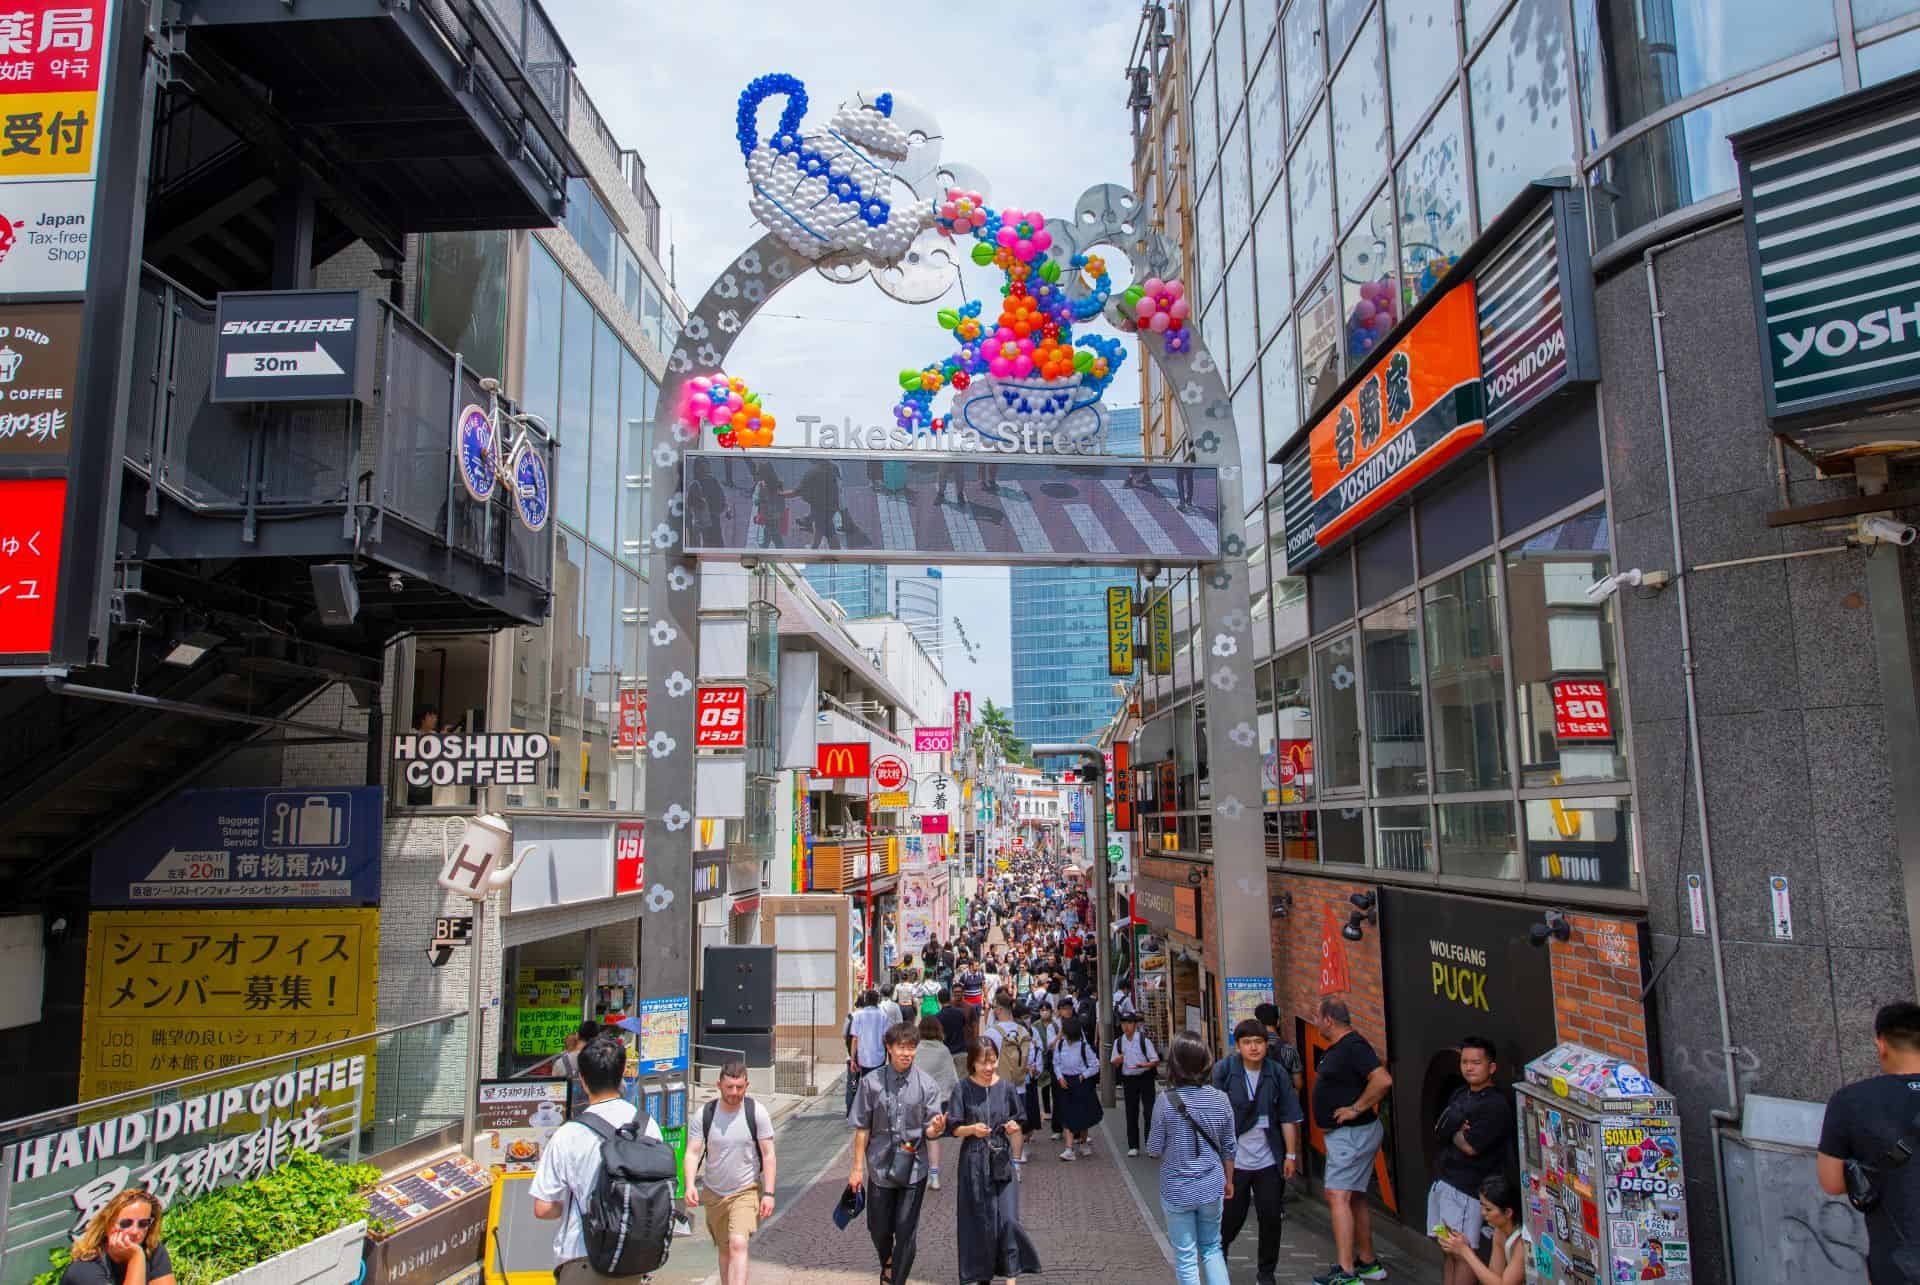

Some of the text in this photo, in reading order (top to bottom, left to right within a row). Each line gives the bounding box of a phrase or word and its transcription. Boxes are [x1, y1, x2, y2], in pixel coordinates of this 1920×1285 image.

[50, 58, 90, 79] 약국
[2, 111, 90, 156] 受付
[36, 212, 86, 228] Japan
[27, 230, 88, 245] Tax-free
[47, 247, 87, 263] Shop
[15, 326, 50, 345] DRIP
[221, 318, 354, 335] SKECHERS
[254, 356, 298, 372] 30m
[1486, 327, 1565, 404] YOSHINOYA
[9, 388, 63, 400] COFFEE
[796, 415, 981, 450] Takeshita
[1338, 428, 1417, 510] YOSHINOYA
[1112, 588, 1130, 664] コインロッカー
[702, 692, 739, 704] クスリ
[700, 708, 741, 727] OS
[700, 731, 741, 741] ドラッグ
[394, 734, 549, 760] HOSHINO
[407, 760, 535, 785] COFFEE
[218, 816, 260, 827] Baggage
[222, 827, 260, 838] Storage
[223, 838, 258, 848] Service
[190, 863, 225, 879] 20m
[236, 852, 348, 878] 荷物預かり
[448, 844, 494, 889] H
[114, 933, 349, 965] シェアオフィス
[1430, 939, 1487, 968] WOLFGANG
[109, 975, 336, 1010] メンバー募集！
[1431, 961, 1489, 1012] PUCK
[101, 1031, 135, 1049] Job
[101, 1054, 135, 1070] Lab
[14, 1055, 366, 1183] HAND DRIP COFFEE
[1604, 1128, 1644, 1146] SONAR
[1620, 1177, 1668, 1192] DEGO
[388, 1243, 448, 1282] HOSHINO
